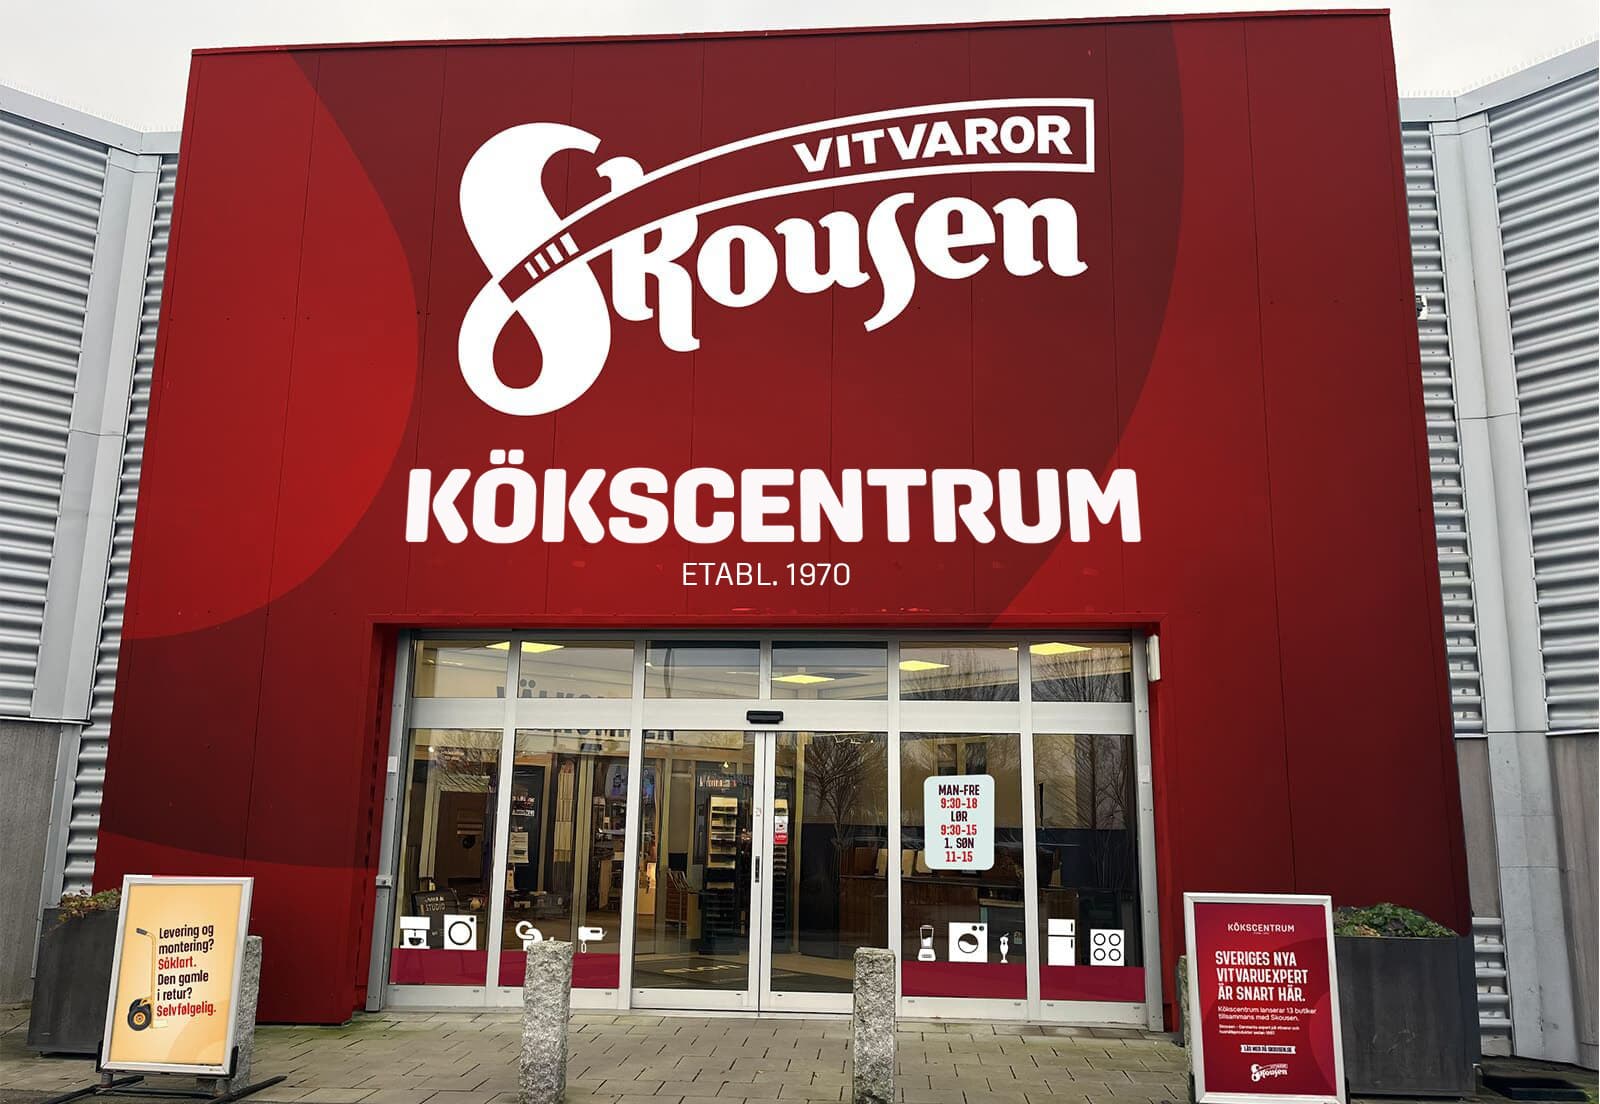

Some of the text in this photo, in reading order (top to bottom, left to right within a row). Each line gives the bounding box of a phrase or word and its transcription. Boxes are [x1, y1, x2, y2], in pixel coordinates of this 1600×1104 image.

[793, 114, 1073, 173] VITVAROR
[458, 121, 1089, 416] Skousen
[405, 449, 1142, 544] KÖKSCENTRUM
[682, 562, 850, 586] ETABL. 1970
[938, 784, 980, 796] MAN-FRE
[940, 797, 978, 809] 9:30-18
[951, 810, 968, 822] LØR
[940, 824, 977, 836] 9:30-15
[944, 837, 975, 849] 1. SØN
[945, 851, 973, 862] 11-15
[159, 924, 214, 940] Levering og
[1227, 922, 1295, 933] KÖKSCENTRUM
[158, 938, 215, 955] montering?
[158, 956, 197, 971] Såklart.
[1215, 950, 1297, 967] SVERIGES NYA
[157, 969, 209, 987] Den gamle
[1216, 967, 1308, 984] VITVARUEXPERT
[163, 987, 192, 1001] retur?
[1218, 982, 1306, 1002] ÄR SNART HÄR.
[156, 1000, 217, 1017] Selvfølgelig.
